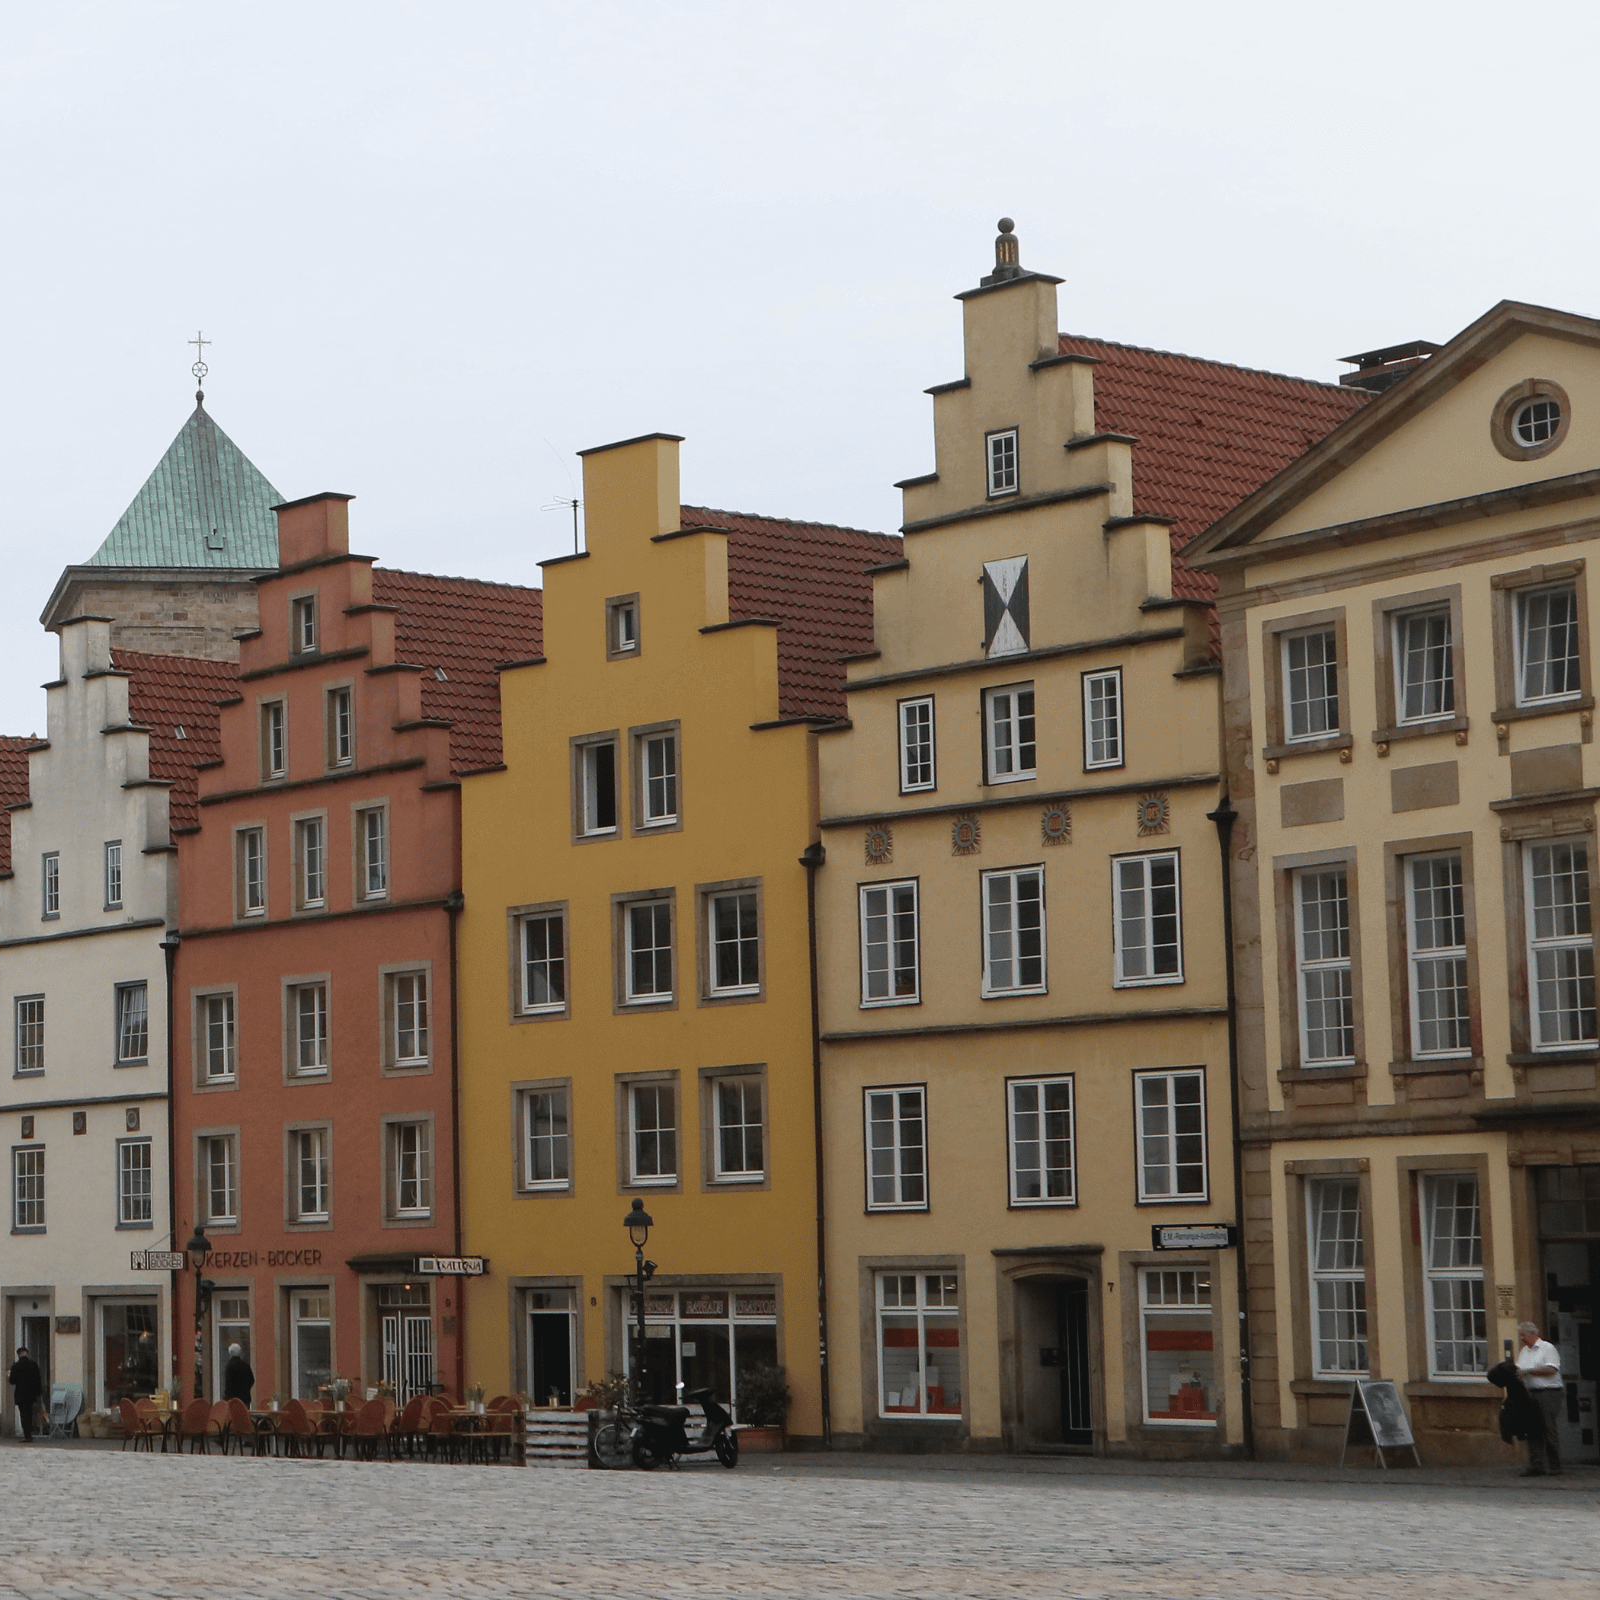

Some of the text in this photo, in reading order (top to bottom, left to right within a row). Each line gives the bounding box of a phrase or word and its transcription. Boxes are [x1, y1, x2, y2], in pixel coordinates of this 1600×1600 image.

[206, 1251, 257, 1268] KERZEN
[436, 1260, 481, 1271] TRATTORIA
[1107, 1282, 1114, 1292] 7
[590, 1297, 597, 1307] 8
